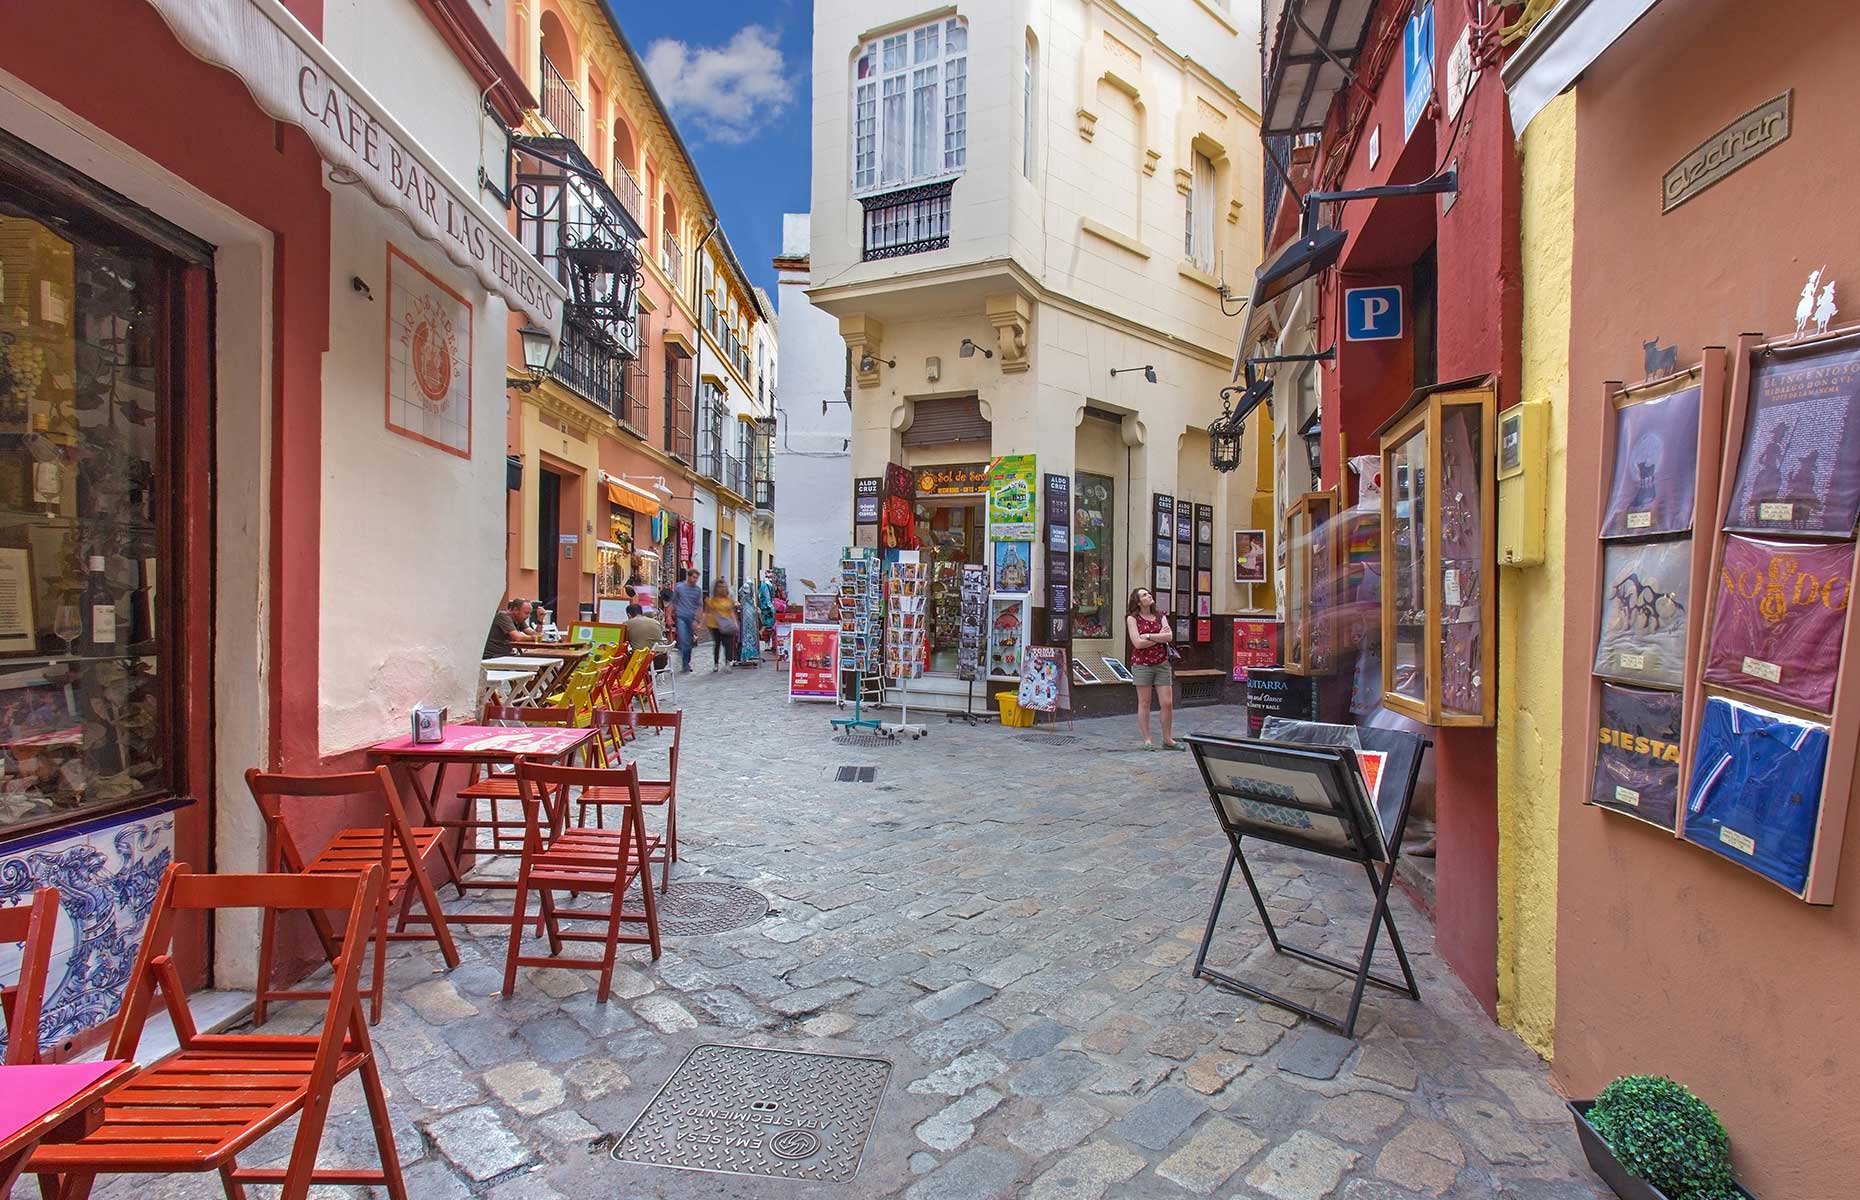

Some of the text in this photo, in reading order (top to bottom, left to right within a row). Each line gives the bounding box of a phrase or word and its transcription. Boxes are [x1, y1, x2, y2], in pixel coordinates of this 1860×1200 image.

[389, 143, 440, 226] BAR
[446, 198, 485, 261] LAS
[489, 238, 553, 320] TERESAS
[1359, 296, 1390, 331] P
[937, 470, 953, 483] Sol
[955, 470, 967, 482] de
[1050, 476, 1067, 484] ALDO
[1050, 483, 1067, 491] CRUZ
[1263, 694, 1283, 703] Dance
[1599, 727, 1681, 764] SIESTA
[686, 1107, 831, 1130] ABASTECIMIENTO
[676, 1130, 763, 1149] EMASESA
